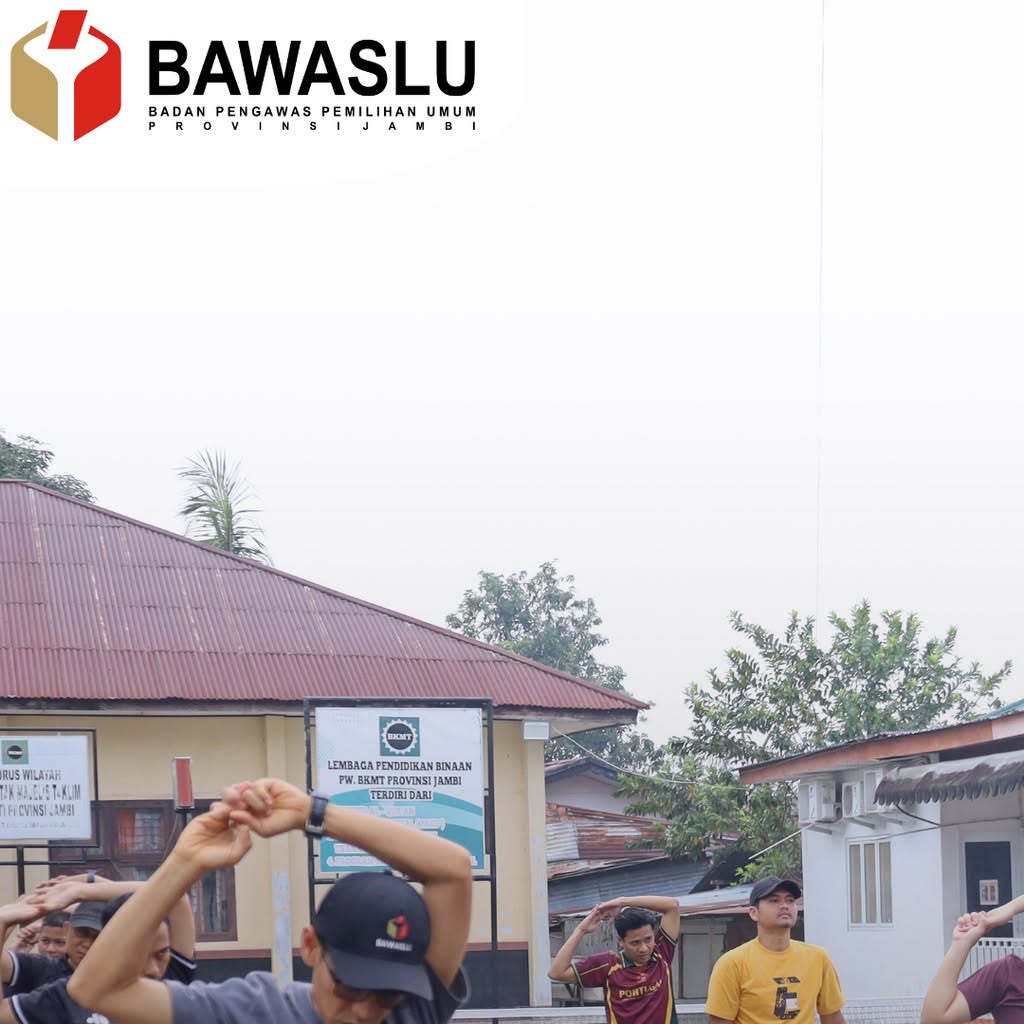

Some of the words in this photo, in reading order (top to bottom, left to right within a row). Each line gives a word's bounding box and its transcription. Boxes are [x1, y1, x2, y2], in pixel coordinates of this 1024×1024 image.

[386, 733, 413, 741] BKMT
[328, 760, 374, 770] LEMBAGA
[376, 761, 434, 771] PENDIDIKAN
[436, 761, 473, 771] BINAAN
[339, 775, 356, 785] PW.
[359, 775, 385, 785] BKMT
[387, 776, 432, 786] PROVINSI
[433, 776, 462, 787] JAMBI
[370, 790, 407, 800] TERDIRI
[409, 790, 432, 800] DARI
